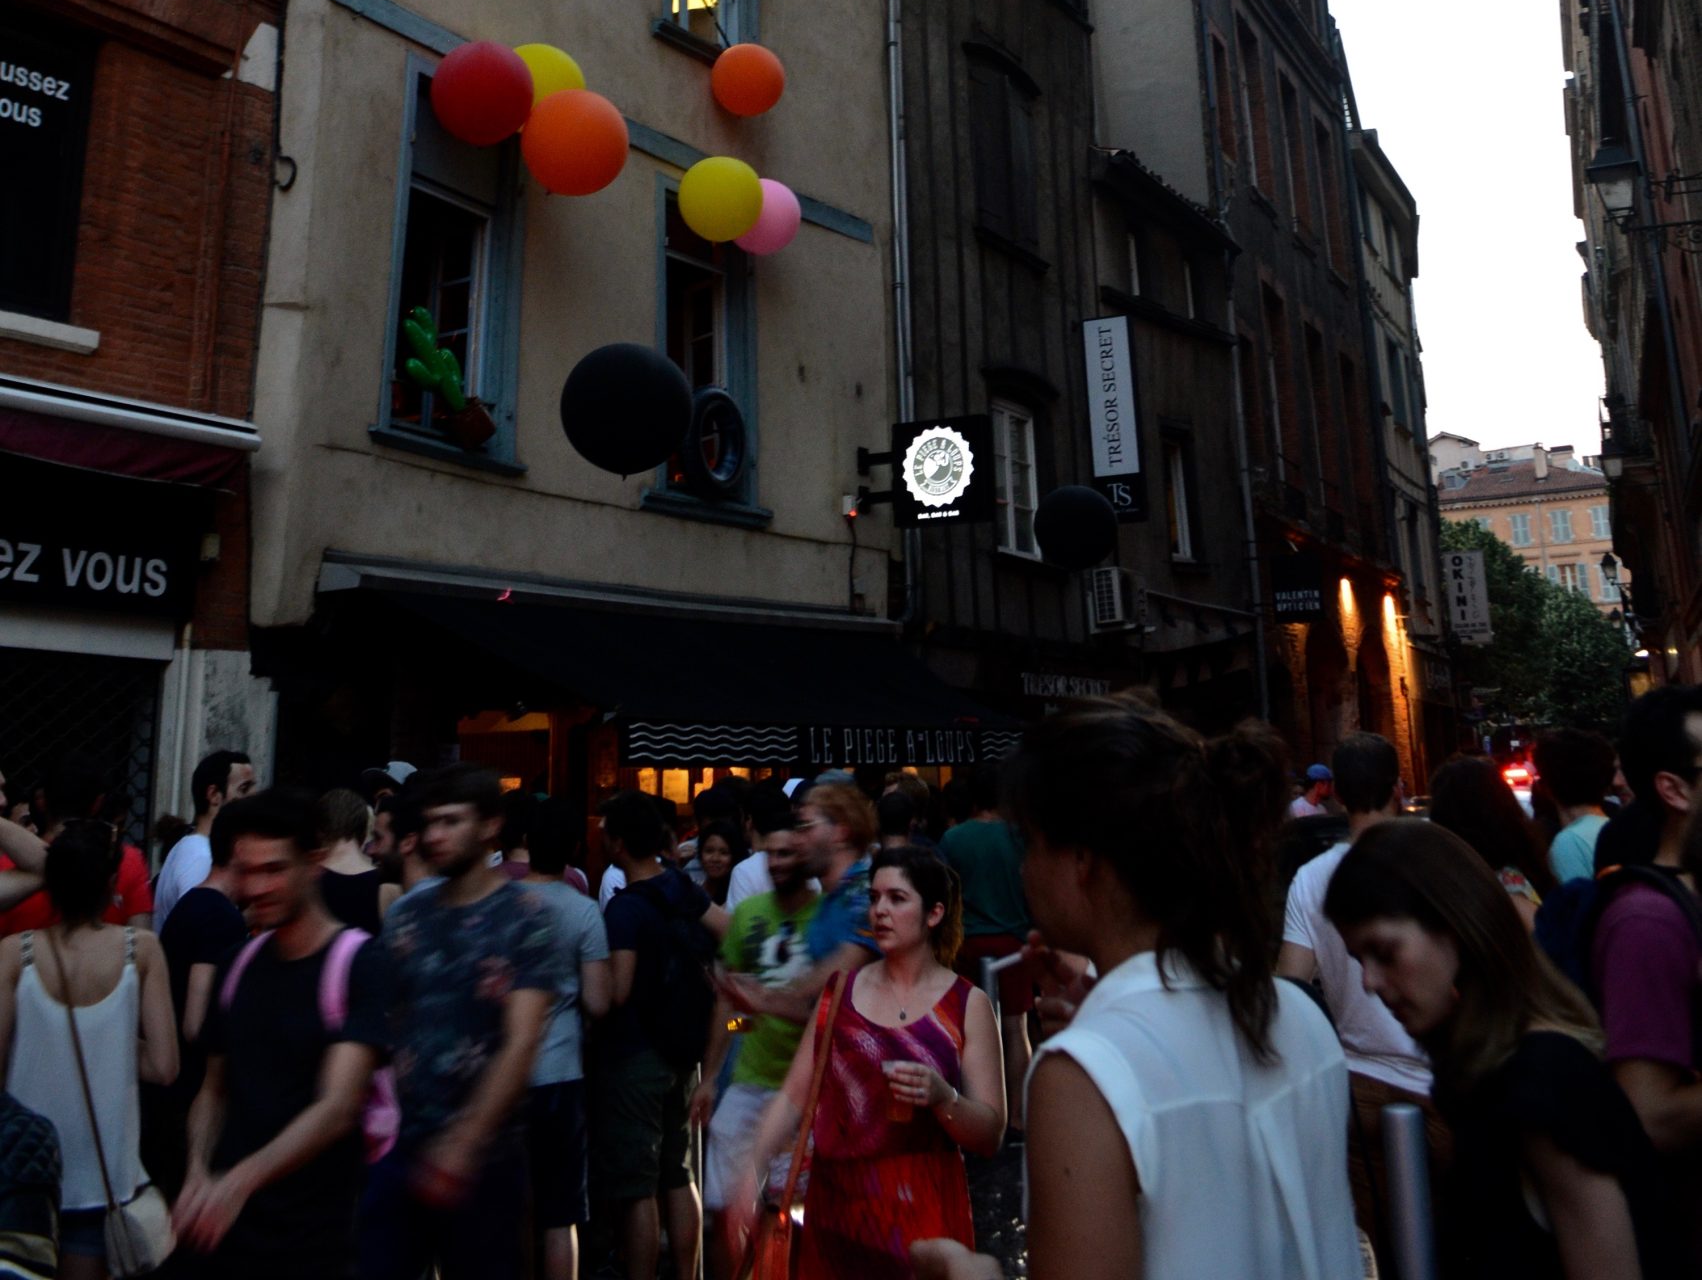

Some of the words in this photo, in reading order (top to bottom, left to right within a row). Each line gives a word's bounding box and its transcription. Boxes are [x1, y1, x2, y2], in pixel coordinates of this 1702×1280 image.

[1098, 326, 1117, 392] SECRET
[1103, 397, 1122, 468] TRÉSOR
[1106, 482, 1132, 506] TS
[61, 547, 168, 597] vous
[1452, 556, 1467, 620] OKINI
[1274, 590, 1320, 600] VALENTIN
[1277, 600, 1320, 612] OPTICIEN
[809, 726, 833, 764] LE
[843, 727, 898, 764] PIEGE
